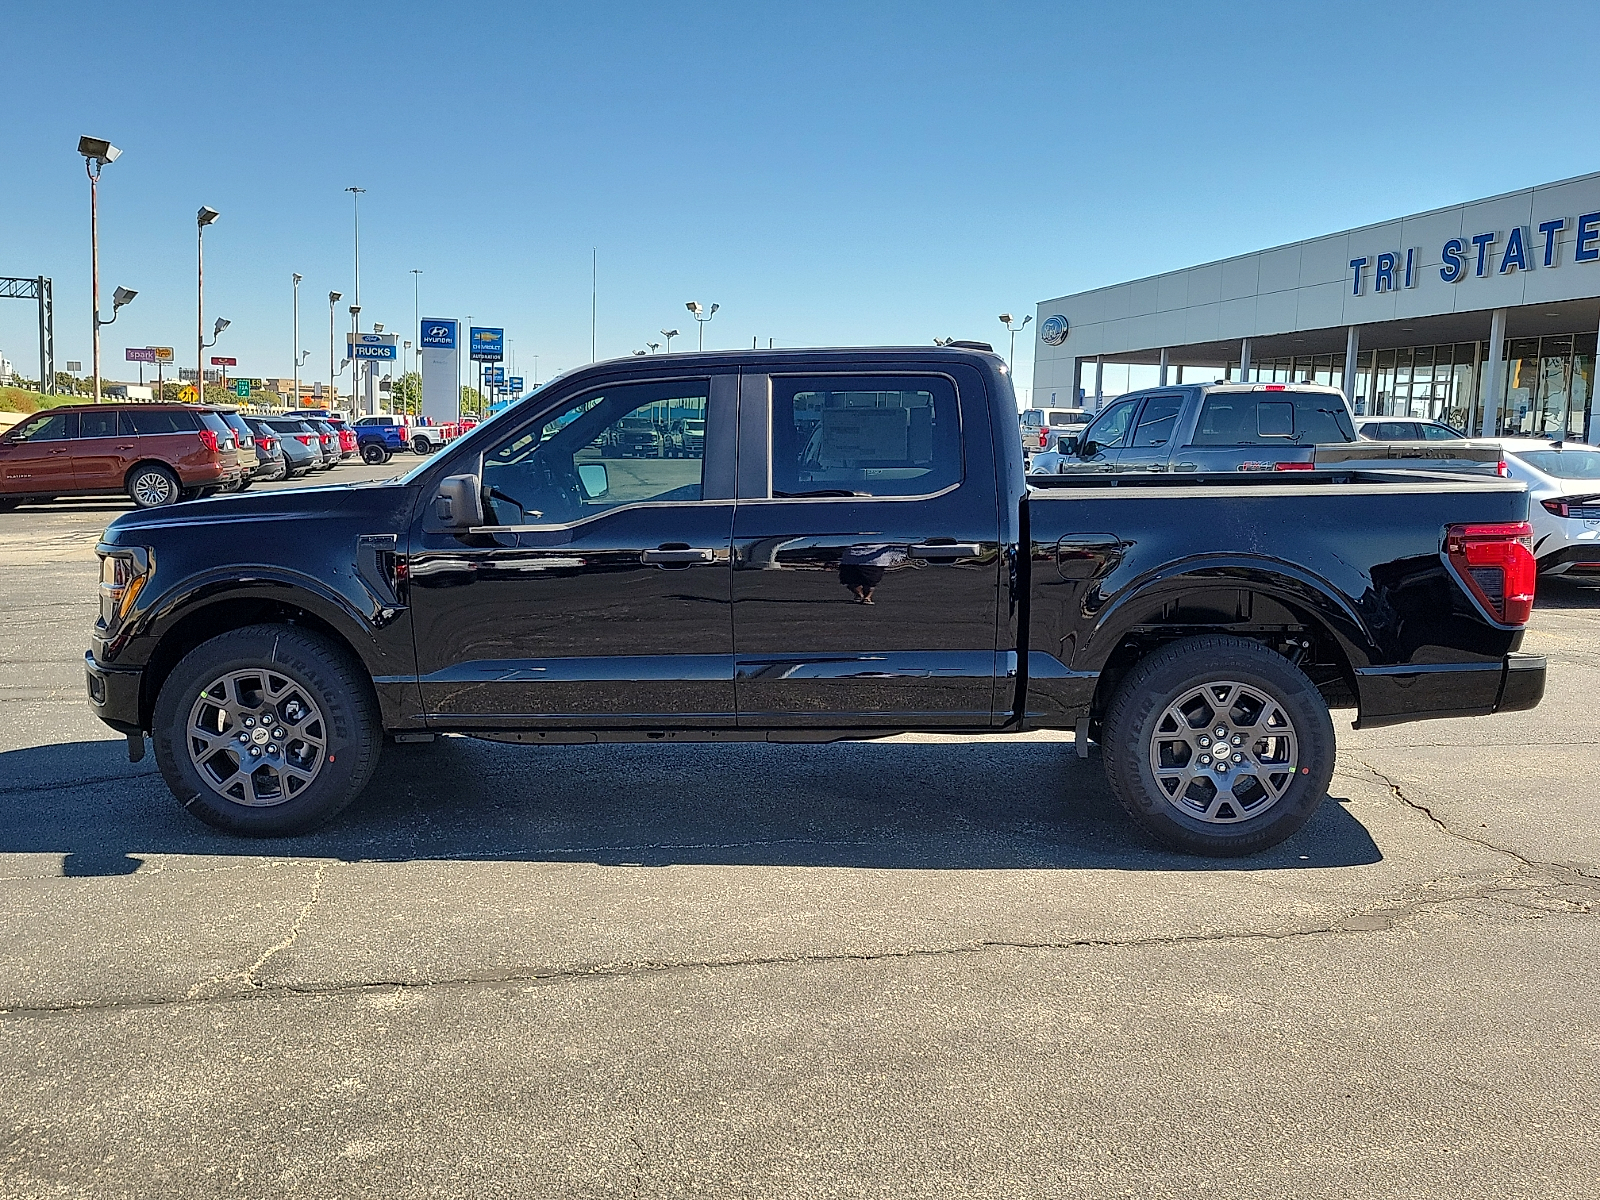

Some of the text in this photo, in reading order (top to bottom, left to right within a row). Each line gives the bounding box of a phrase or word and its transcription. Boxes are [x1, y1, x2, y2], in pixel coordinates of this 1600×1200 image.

[1350, 211, 1600, 297] TRI STATE
[130, 351, 153, 360] spark
[355, 347, 391, 357] TRUCKS
